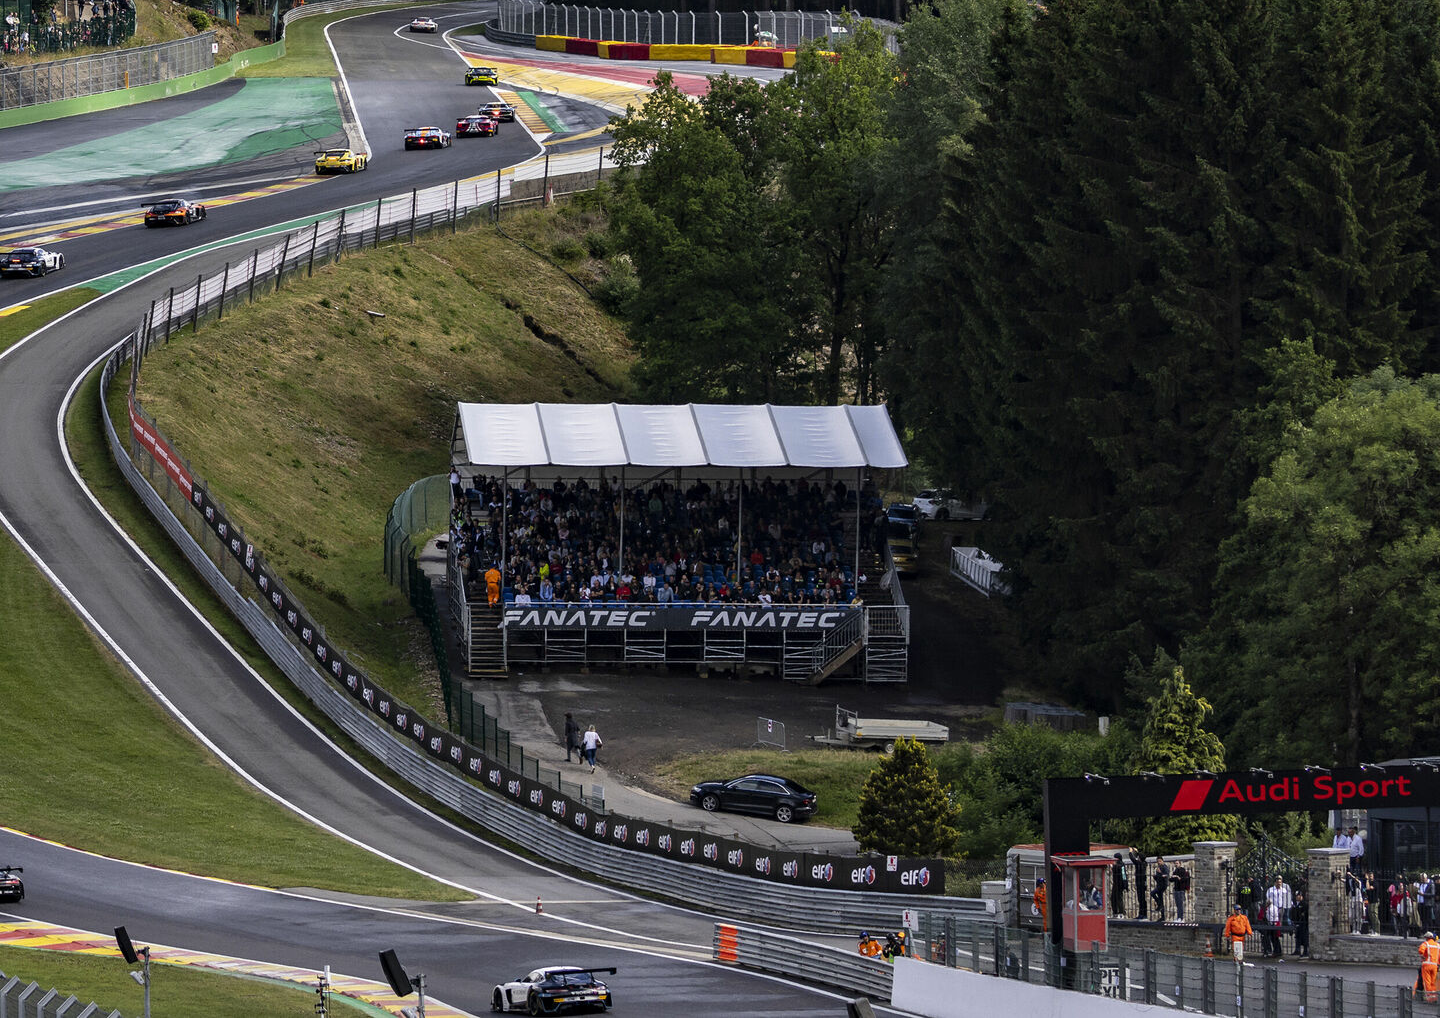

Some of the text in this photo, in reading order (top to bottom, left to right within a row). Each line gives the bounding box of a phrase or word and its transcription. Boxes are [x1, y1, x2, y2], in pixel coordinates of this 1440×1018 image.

[504, 610, 649, 627] FANATEC
[691, 611, 840, 628] FANATEC
[1218, 775, 1411, 805] Audi Sport
[812, 864, 825, 879] elf
[851, 868, 865, 882] elf
[901, 870, 918, 885] elf
